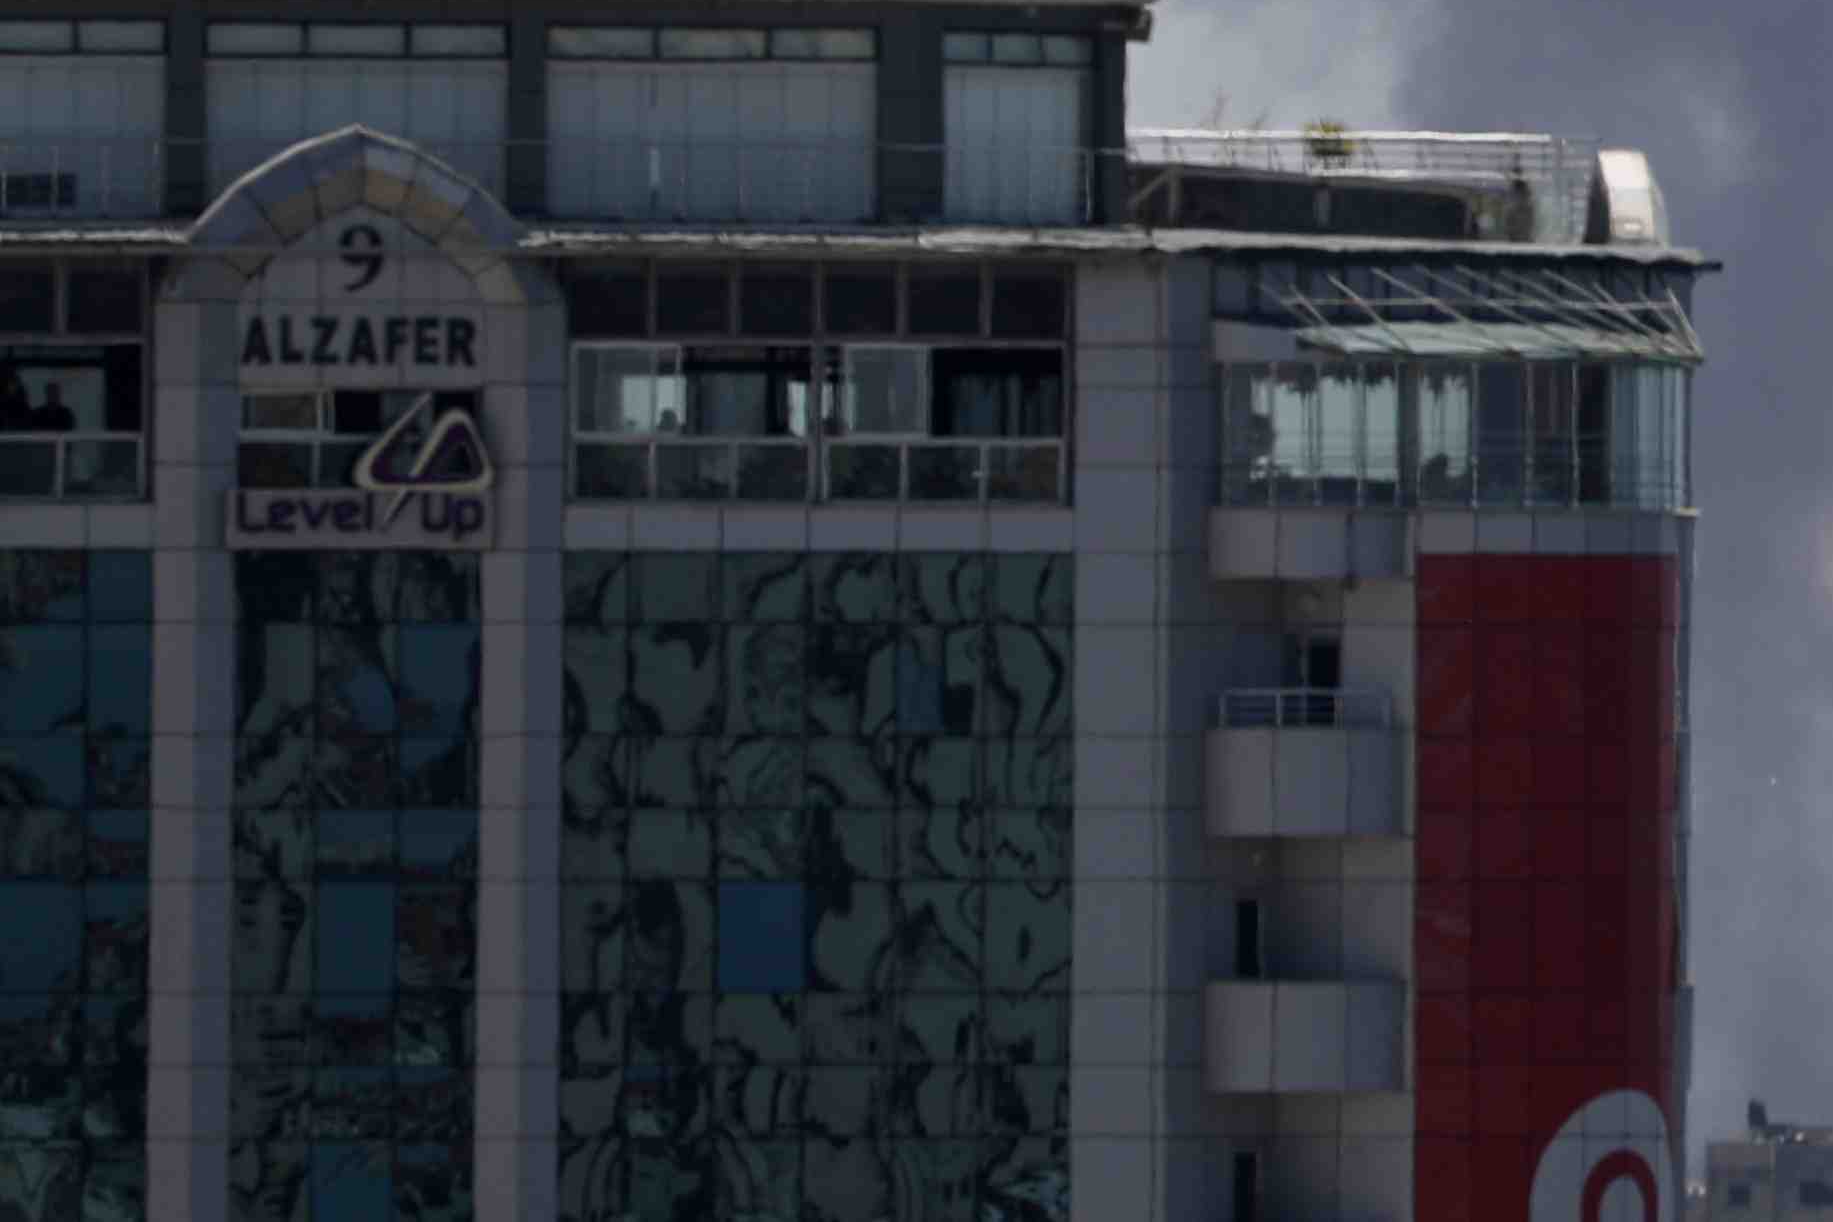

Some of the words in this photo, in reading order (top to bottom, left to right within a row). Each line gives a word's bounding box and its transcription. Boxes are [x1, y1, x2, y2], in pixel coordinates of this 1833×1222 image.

[338, 224, 383, 291] 9
[241, 316, 477, 366] ALZAFER
[237, 492, 375, 533] Level
[421, 494, 484, 540] Up
